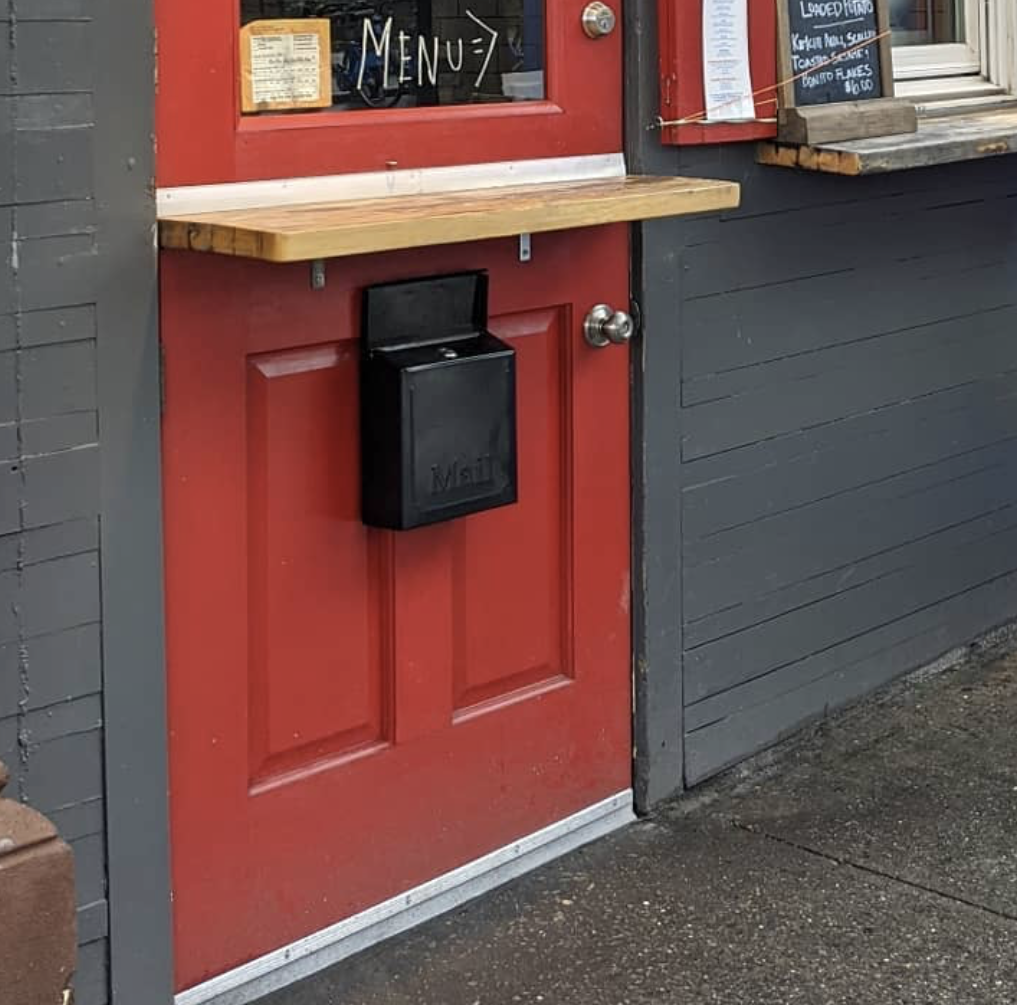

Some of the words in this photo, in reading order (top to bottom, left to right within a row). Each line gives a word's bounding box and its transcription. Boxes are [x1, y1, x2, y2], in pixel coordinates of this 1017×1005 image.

[800, 0, 842, 18] LOADED
[356, 17, 463, 90] MENU
[835, 64, 873, 79] FLAKES
[431, 452, 494, 495] Mail
